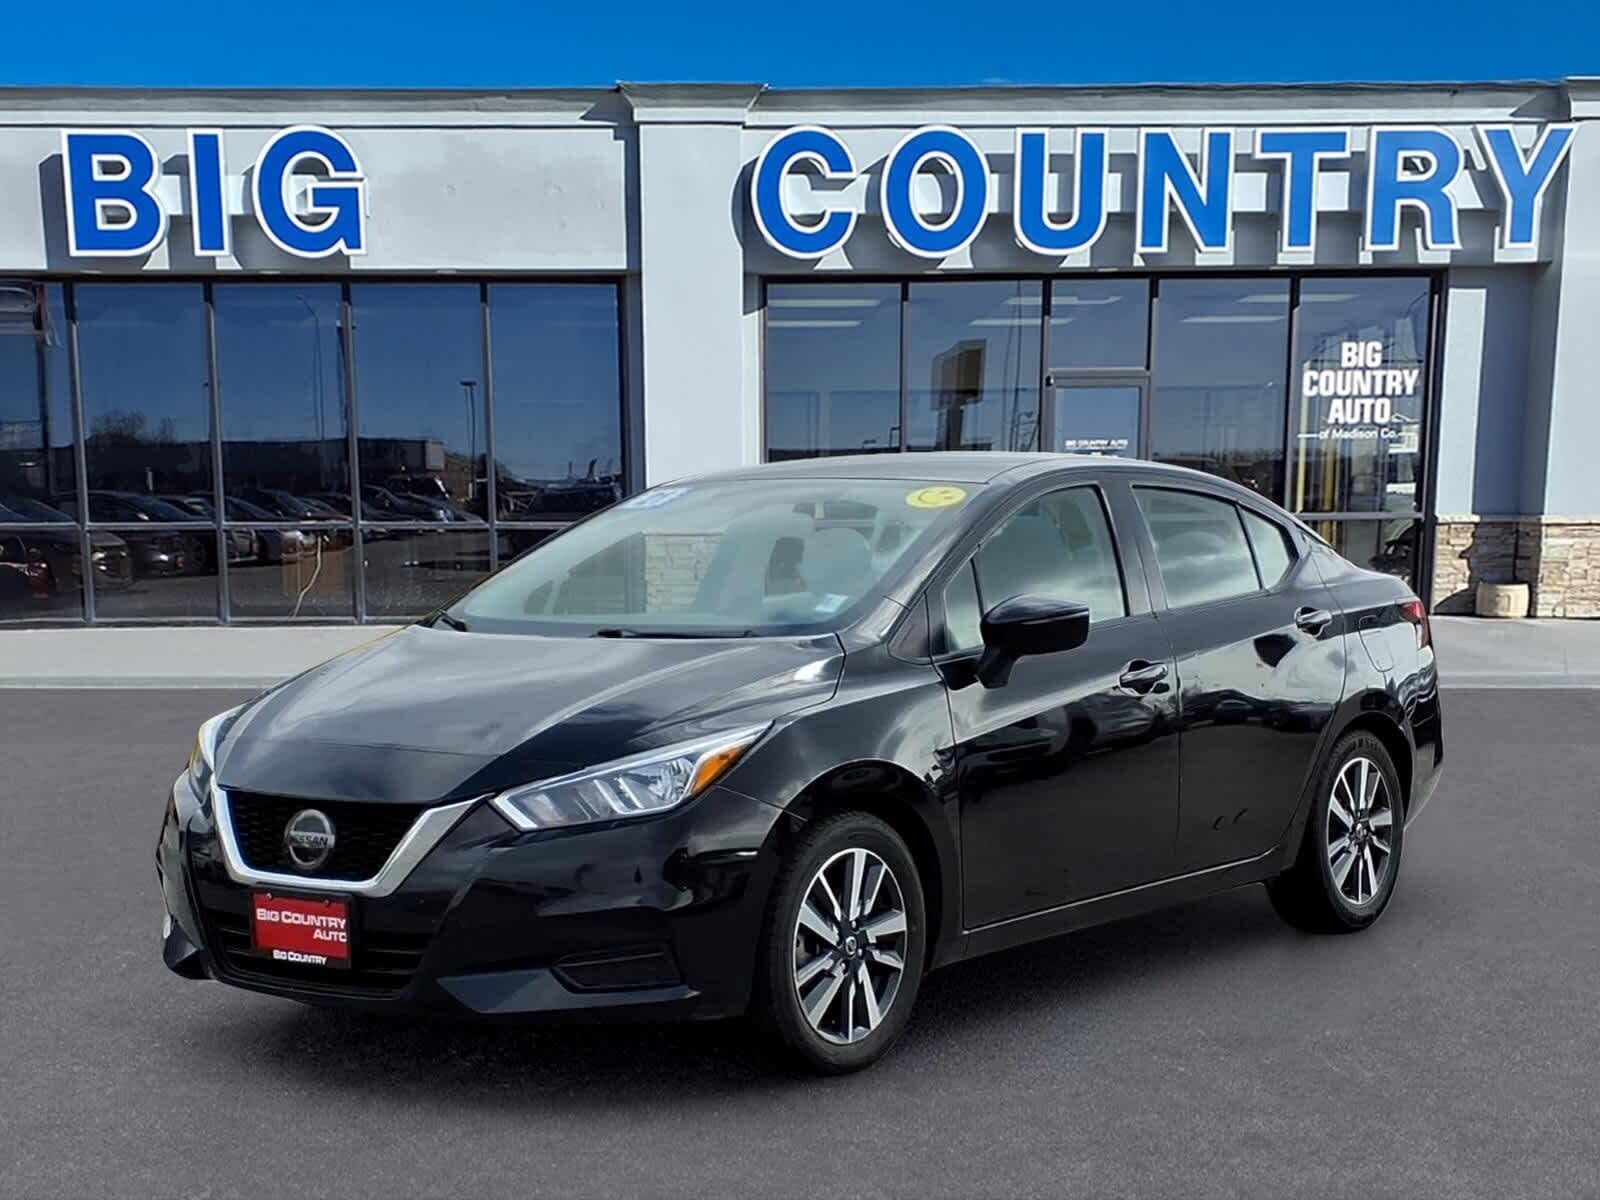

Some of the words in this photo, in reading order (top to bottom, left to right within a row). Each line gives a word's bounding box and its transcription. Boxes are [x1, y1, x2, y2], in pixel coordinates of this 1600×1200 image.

[61, 125, 367, 257] BIG
[751, 123, 1575, 260] COUNTRY
[1341, 341, 1382, 368] BIG
[1303, 369, 1419, 396] COUNTRY
[1328, 398, 1391, 424] AUTO
[1319, 430, 1329, 440] of
[1332, 429, 1378, 440] Madison
[290, 833, 329, 848] NISSAN
